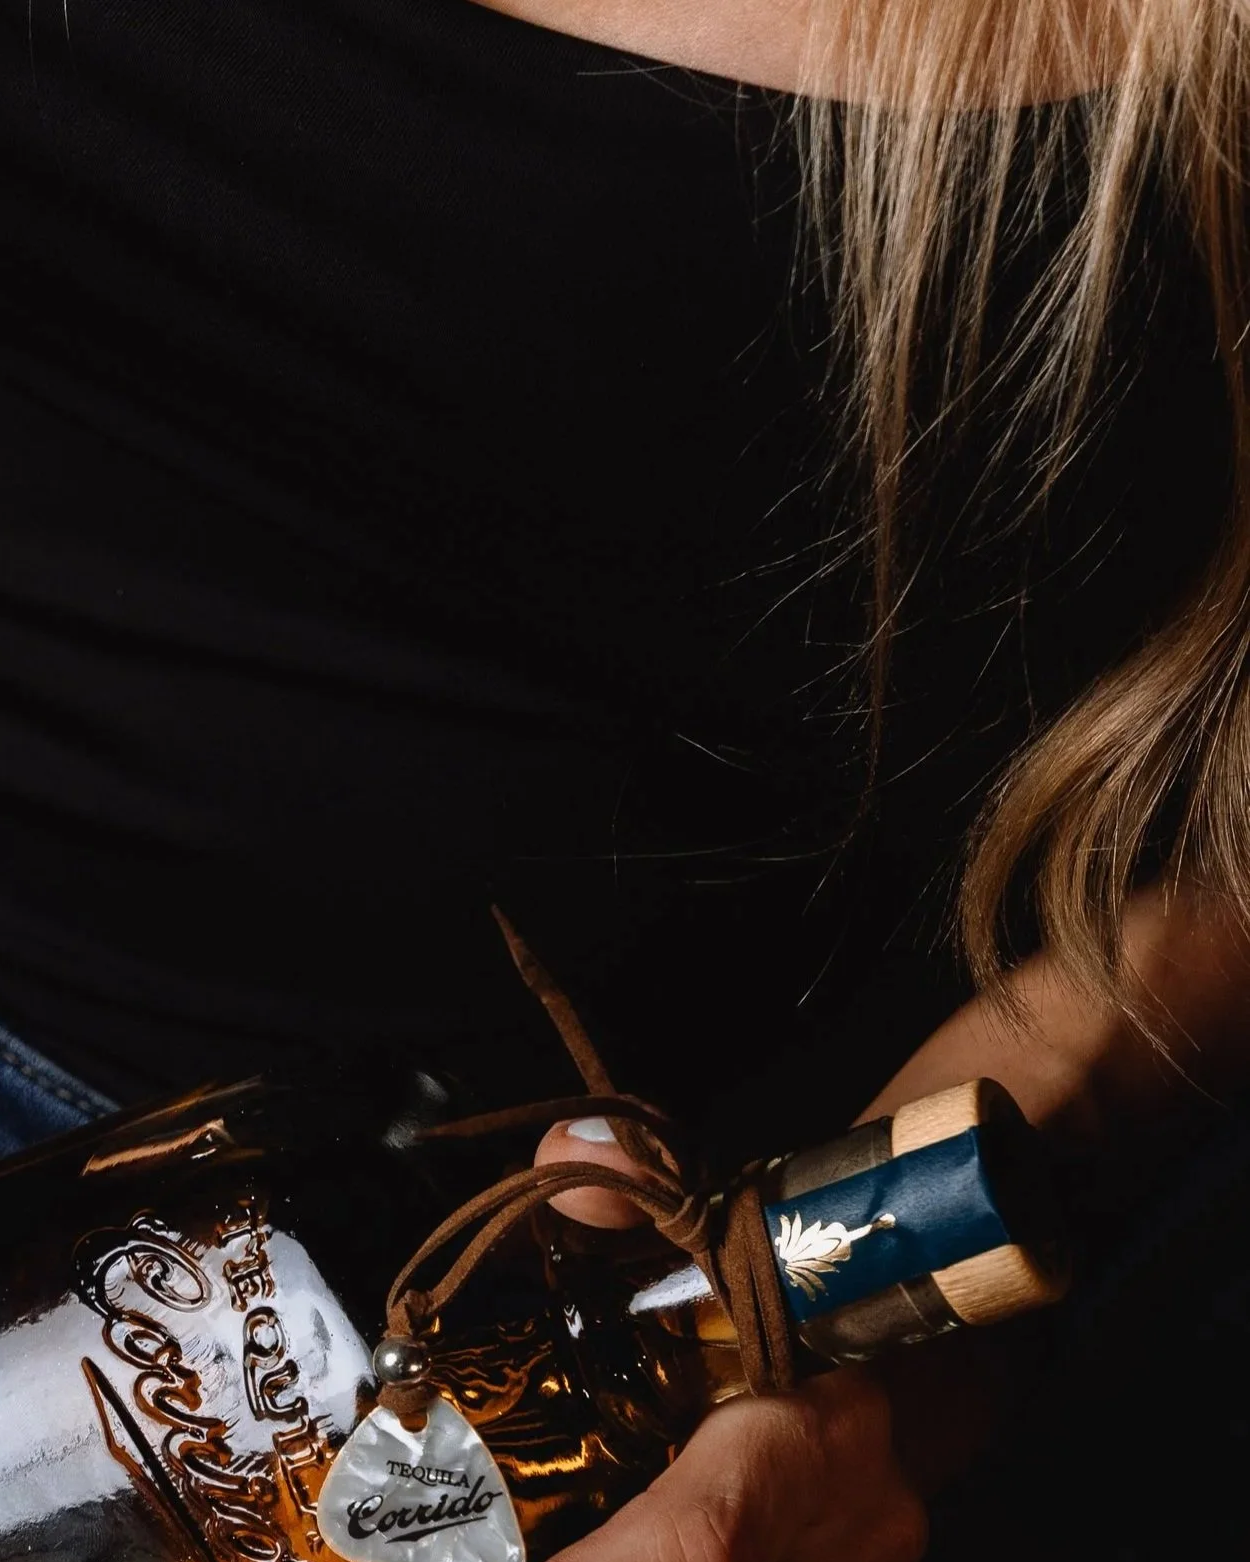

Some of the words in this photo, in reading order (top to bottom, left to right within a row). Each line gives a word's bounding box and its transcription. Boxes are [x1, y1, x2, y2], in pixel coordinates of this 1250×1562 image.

[214, 1200, 334, 1556] TEQUIL
[386, 1460, 471, 1489] TEQUILA
[347, 1475, 503, 1539] Corrido
